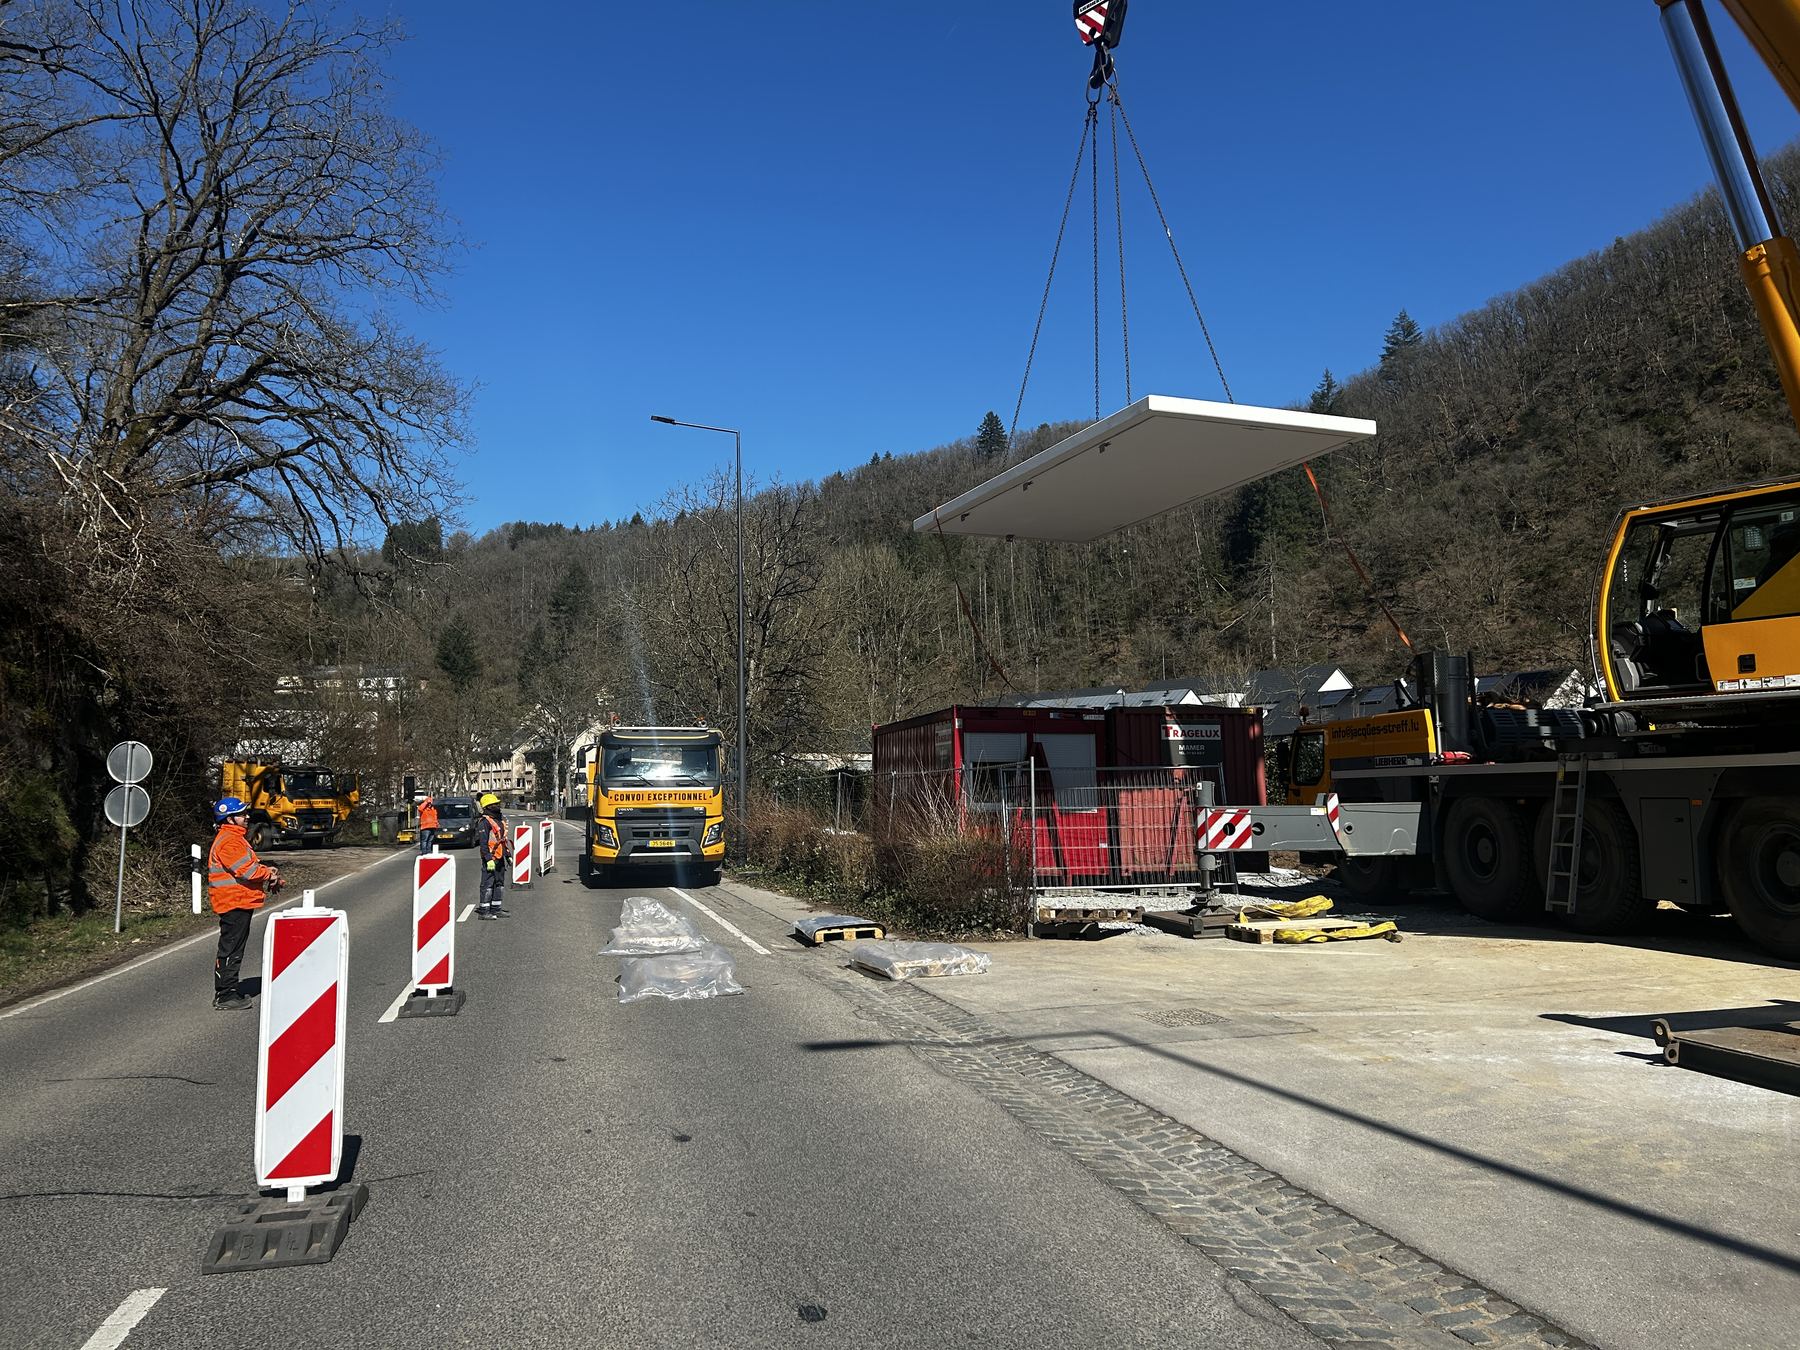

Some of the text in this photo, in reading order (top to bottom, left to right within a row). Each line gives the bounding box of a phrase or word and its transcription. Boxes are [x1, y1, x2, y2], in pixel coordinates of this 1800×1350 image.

[1162, 726, 1220, 738] TRAGELUX
[1375, 757, 1407, 767] LIEBHERR
[614, 792, 707, 801] CONVOI EXCEPTIONNEL
